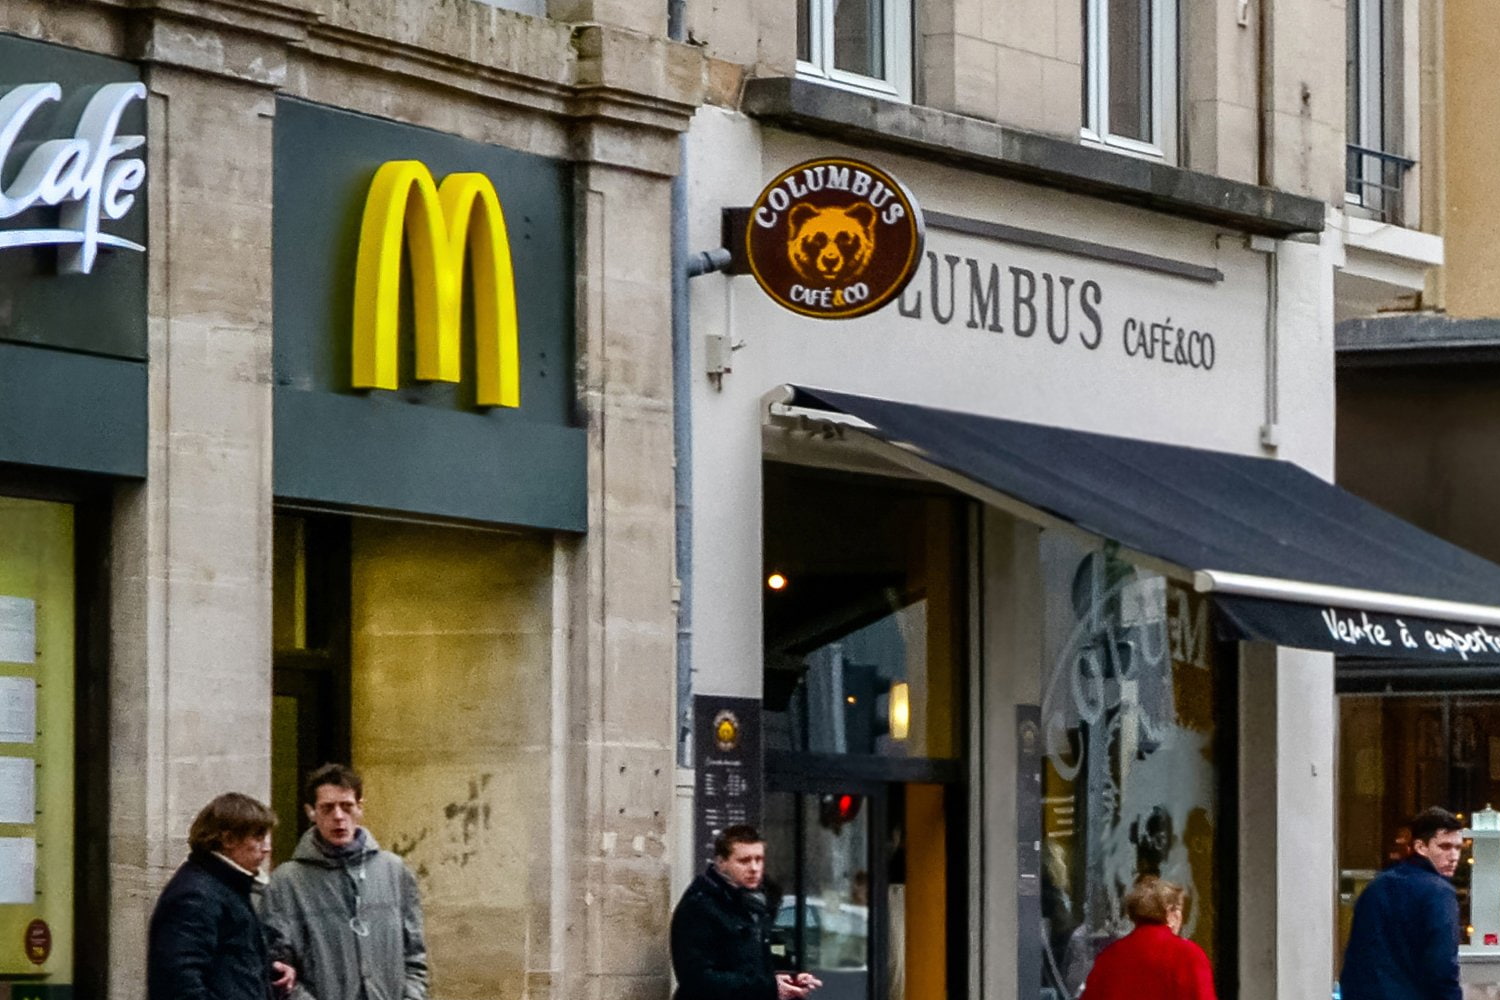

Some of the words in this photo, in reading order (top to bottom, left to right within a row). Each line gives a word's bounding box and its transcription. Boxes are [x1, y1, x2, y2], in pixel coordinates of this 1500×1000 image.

[755, 165, 905, 228] COLUMBUS
[789, 282, 869, 308] CAFÉ&CO
[1123, 317, 1215, 370] CAFÉ&CO
[1321, 607, 1392, 647] Vente
[1396, 619, 1418, 648] à
